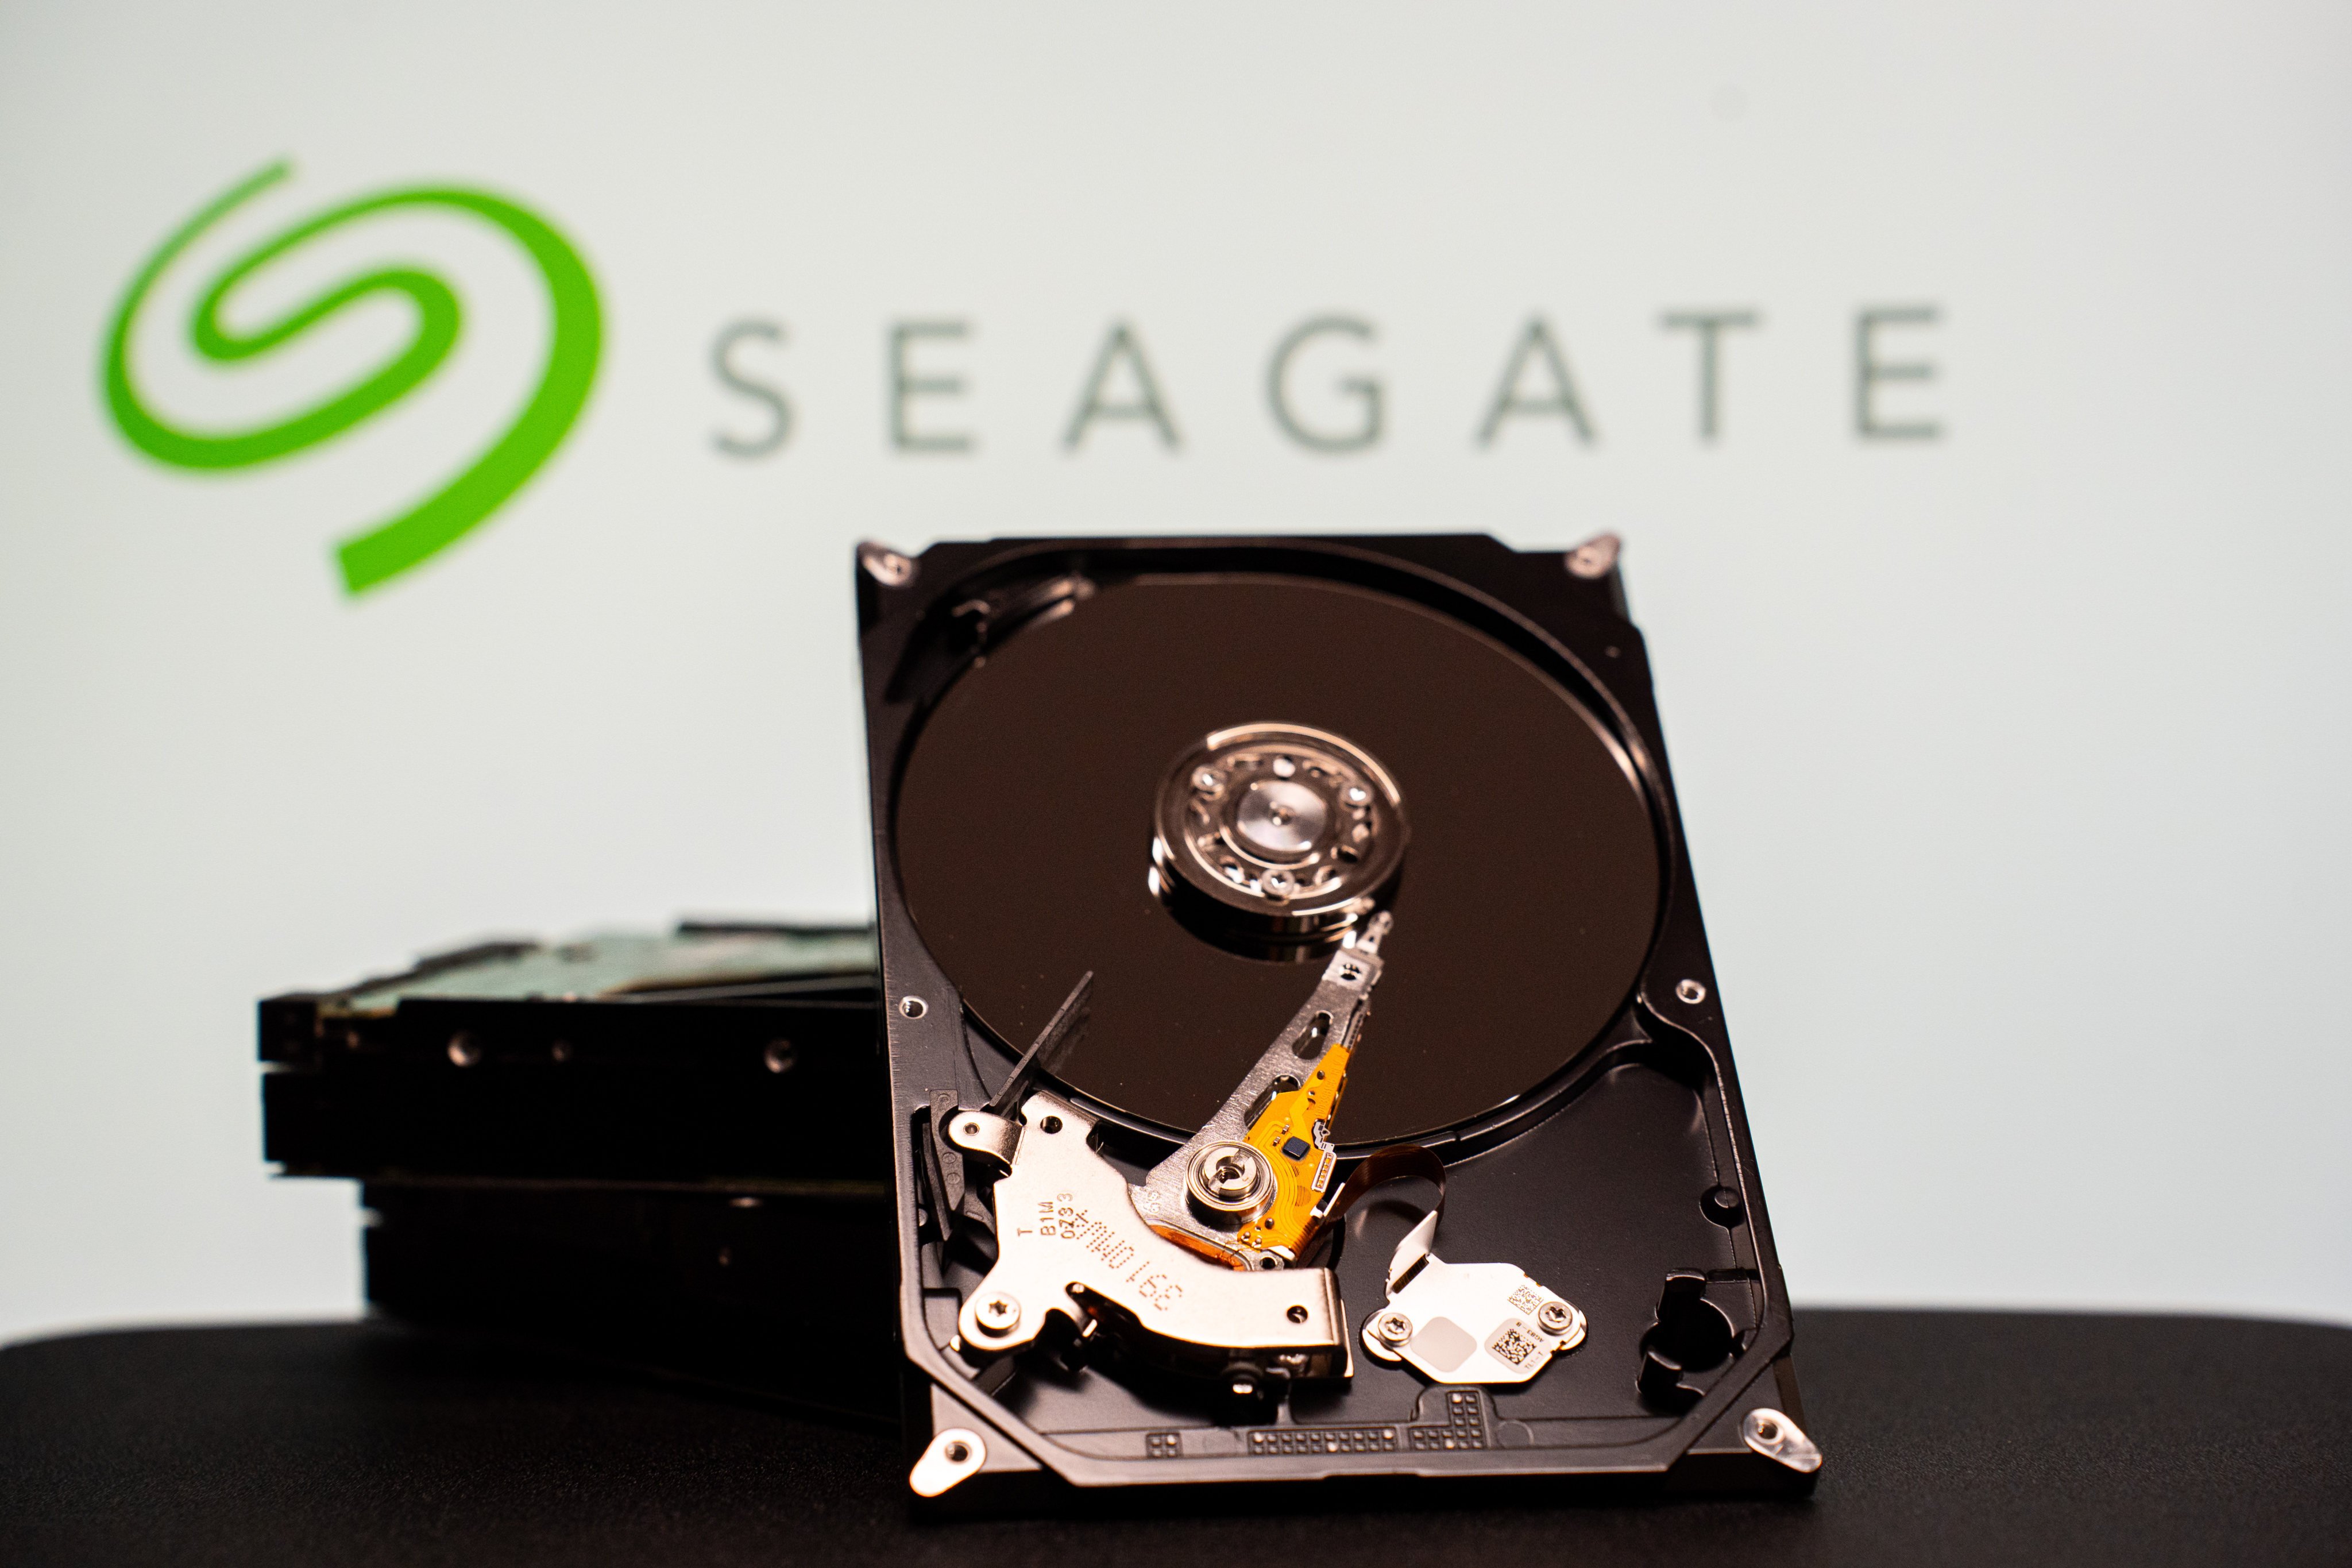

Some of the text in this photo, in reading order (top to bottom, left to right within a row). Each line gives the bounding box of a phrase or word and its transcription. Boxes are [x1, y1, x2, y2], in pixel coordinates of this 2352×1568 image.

[708, 303, 1945, 462] SEAGATE
[1017, 1227, 1033, 1237] T
[1038, 1201, 1056, 1236] B1M
[1057, 1193, 1076, 1239] 0733
